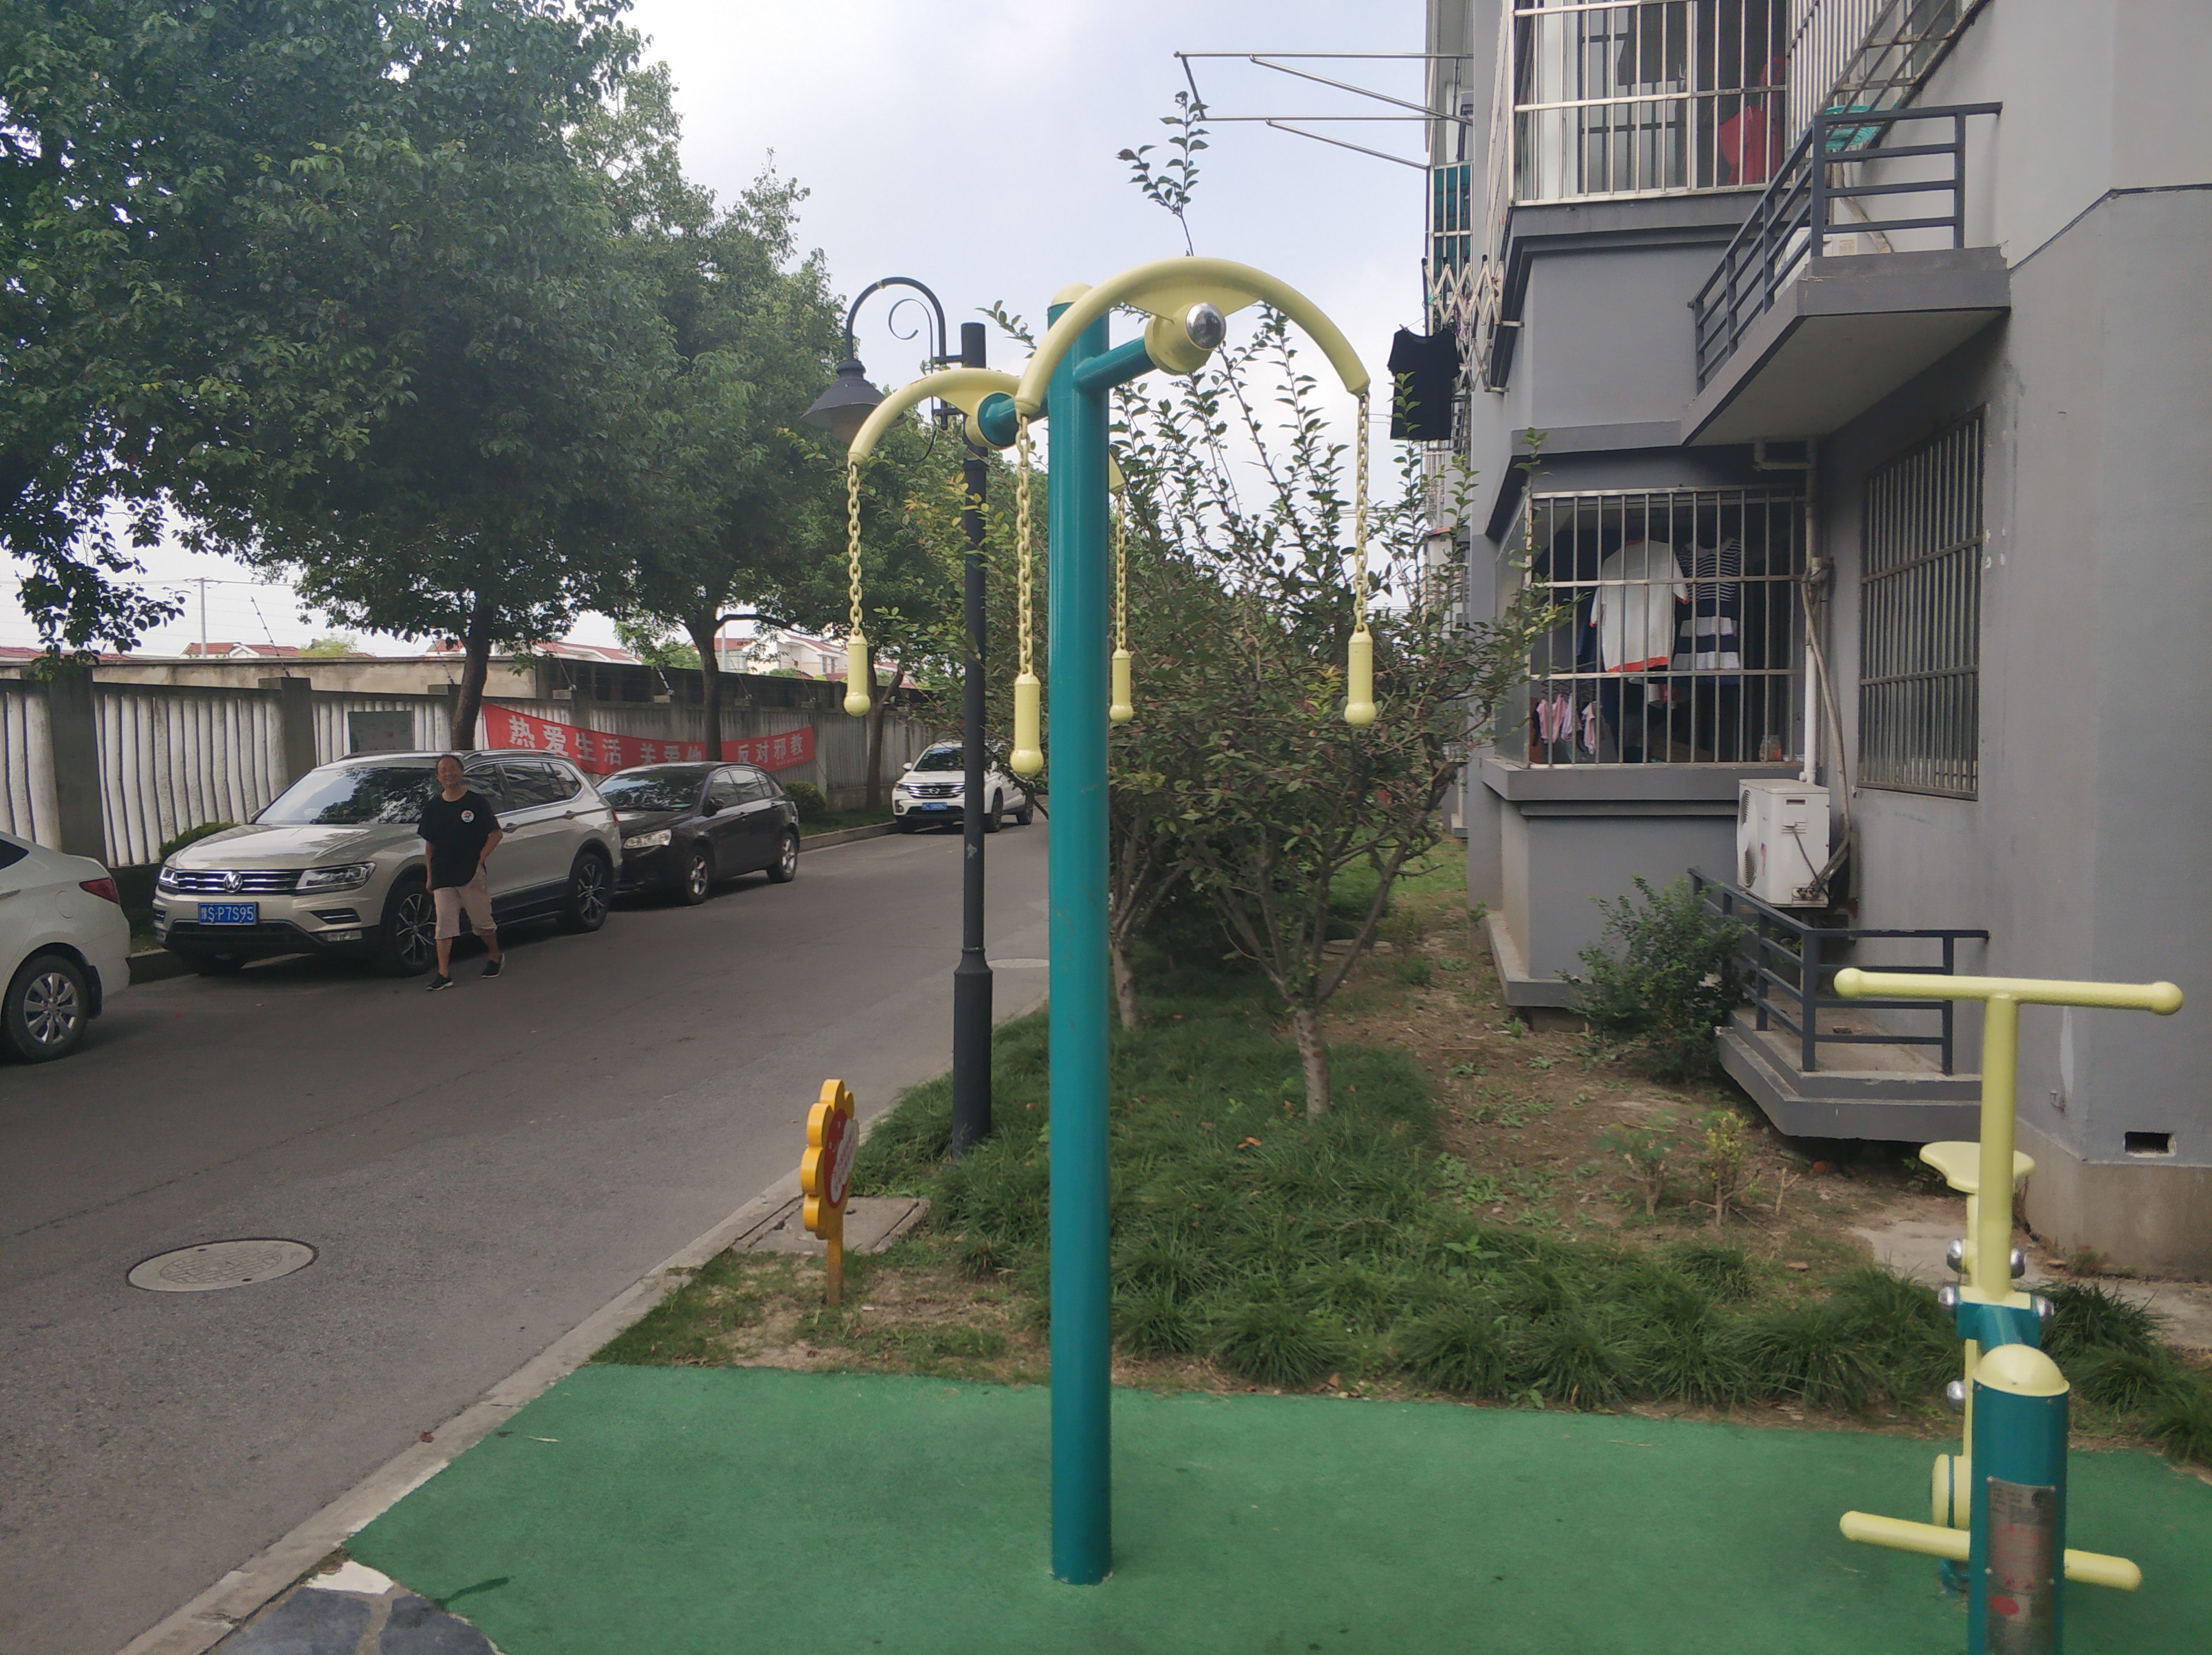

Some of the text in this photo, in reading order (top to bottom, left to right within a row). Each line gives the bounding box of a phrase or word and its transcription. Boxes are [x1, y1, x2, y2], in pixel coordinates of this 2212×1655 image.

[509, 714, 803, 765] 热爱生活 关爱他 反对邪教
